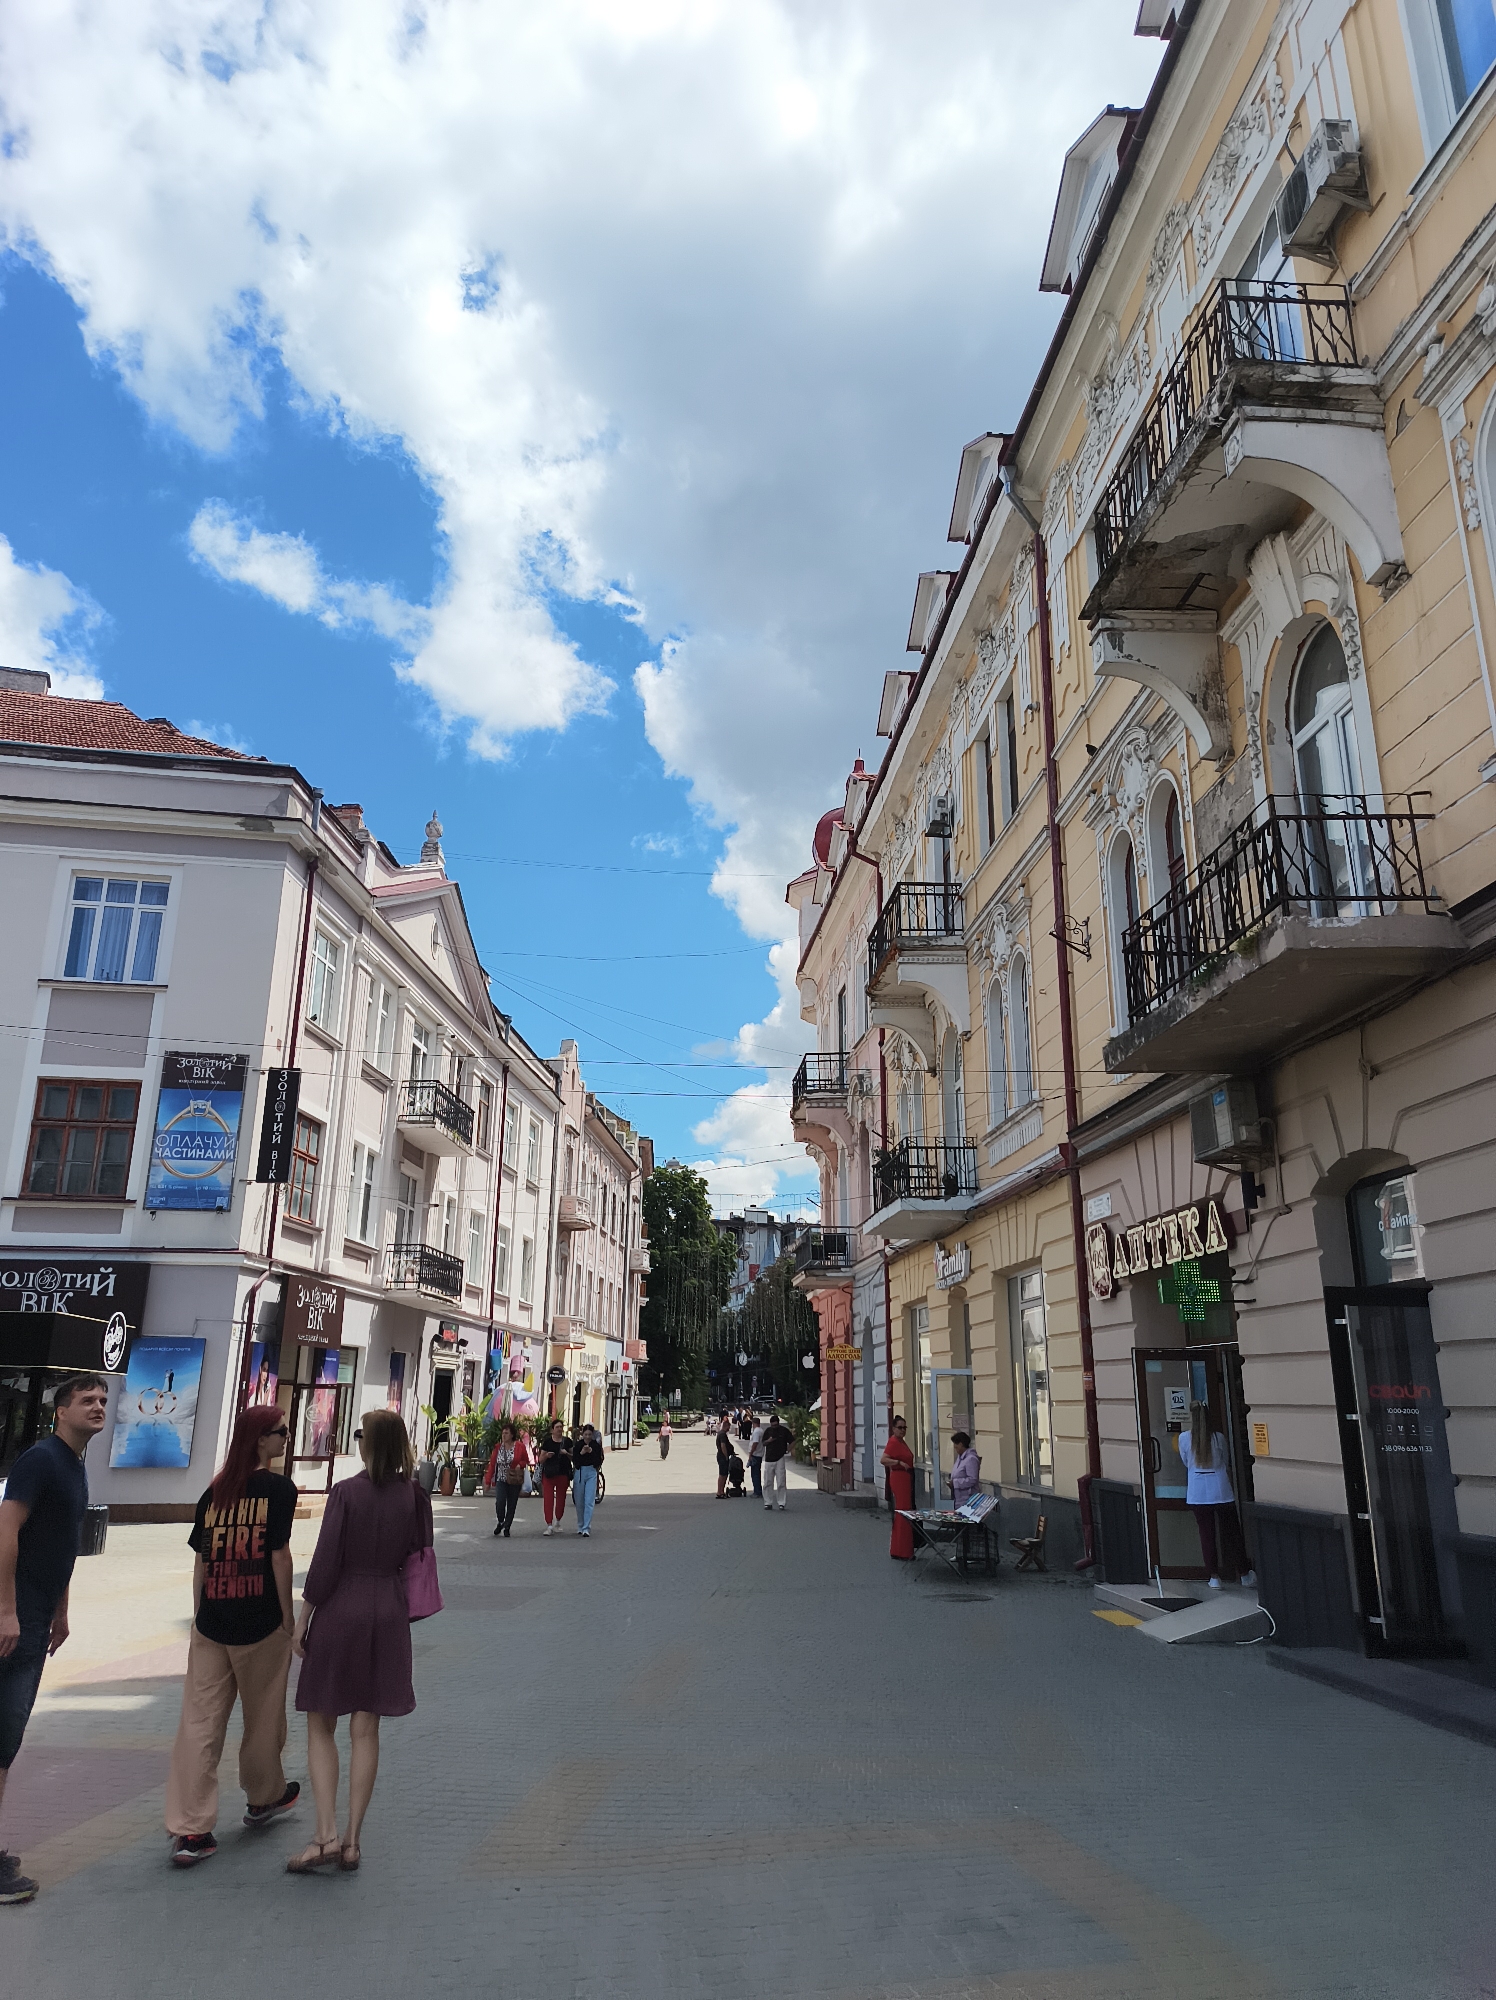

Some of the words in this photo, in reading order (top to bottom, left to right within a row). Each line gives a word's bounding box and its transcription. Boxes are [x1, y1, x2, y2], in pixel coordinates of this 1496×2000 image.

[192, 1067, 215, 1078] ВІК
[156, 1133, 235, 1149] ОПЛАЧУЙ
[154, 1147, 234, 1160] ЧАСТИНАМИ
[1113, 1200, 1228, 1279] АПТЕКА
[938, 1242, 966, 1279] Family
[0, 1266, 117, 1296] ОЛОТИЙ
[20, 1291, 74, 1313] ВІК
[307, 1306, 325, 1331] ВІК
[1392, 1444, 1406, 1452] 096
[210, 1525, 267, 1560] FIRE
[213, 1561, 238, 1577] FIND
[206, 1574, 264, 1600] RENGTH
